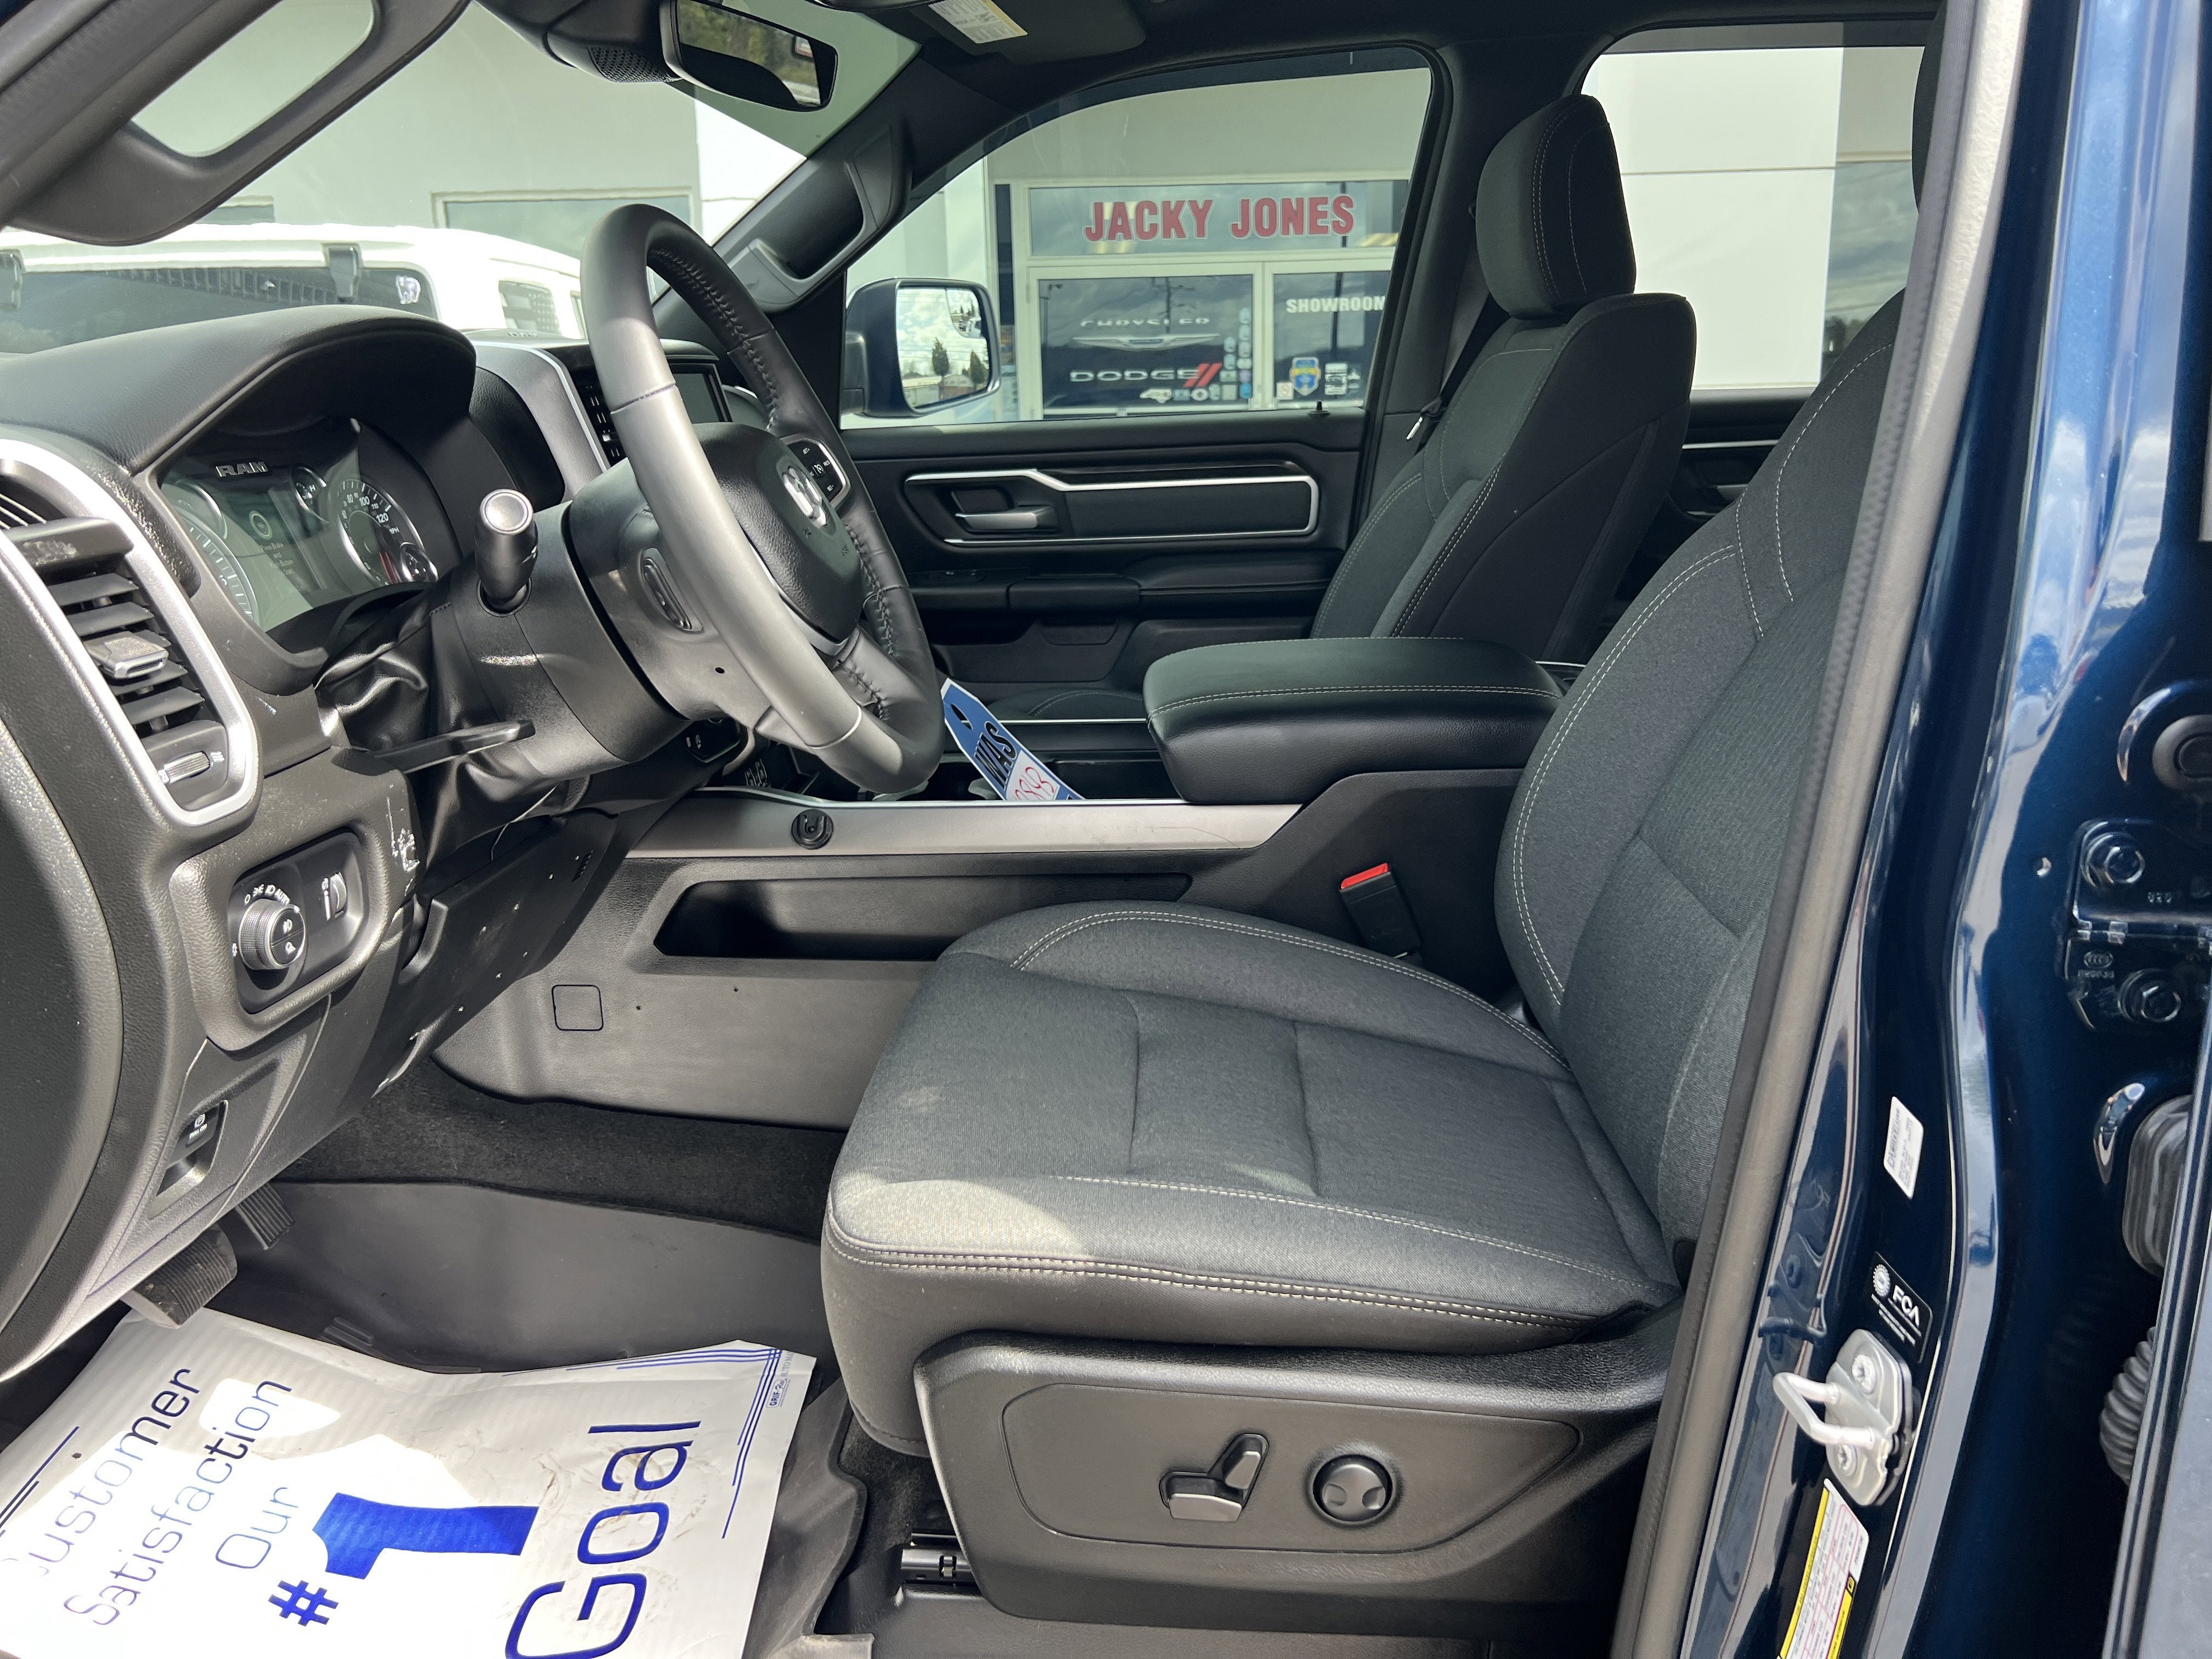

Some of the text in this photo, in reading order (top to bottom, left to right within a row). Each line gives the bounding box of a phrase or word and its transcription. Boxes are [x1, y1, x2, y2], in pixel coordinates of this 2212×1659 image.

[1084, 195, 1355, 241] JACKY JONES
[1286, 296, 1386, 313] SHOWROOM
[1070, 369, 1199, 382] DODGE
[215, 461, 268, 477] RAM
[359, 496, 370, 506] 100
[376, 512, 389, 523] 120
[974, 721, 1017, 791] WAS
[63, 1380, 292, 1626] Satisfaction
[215, 1486, 299, 1569] Our
[505, 1420, 702, 1659] Goal
